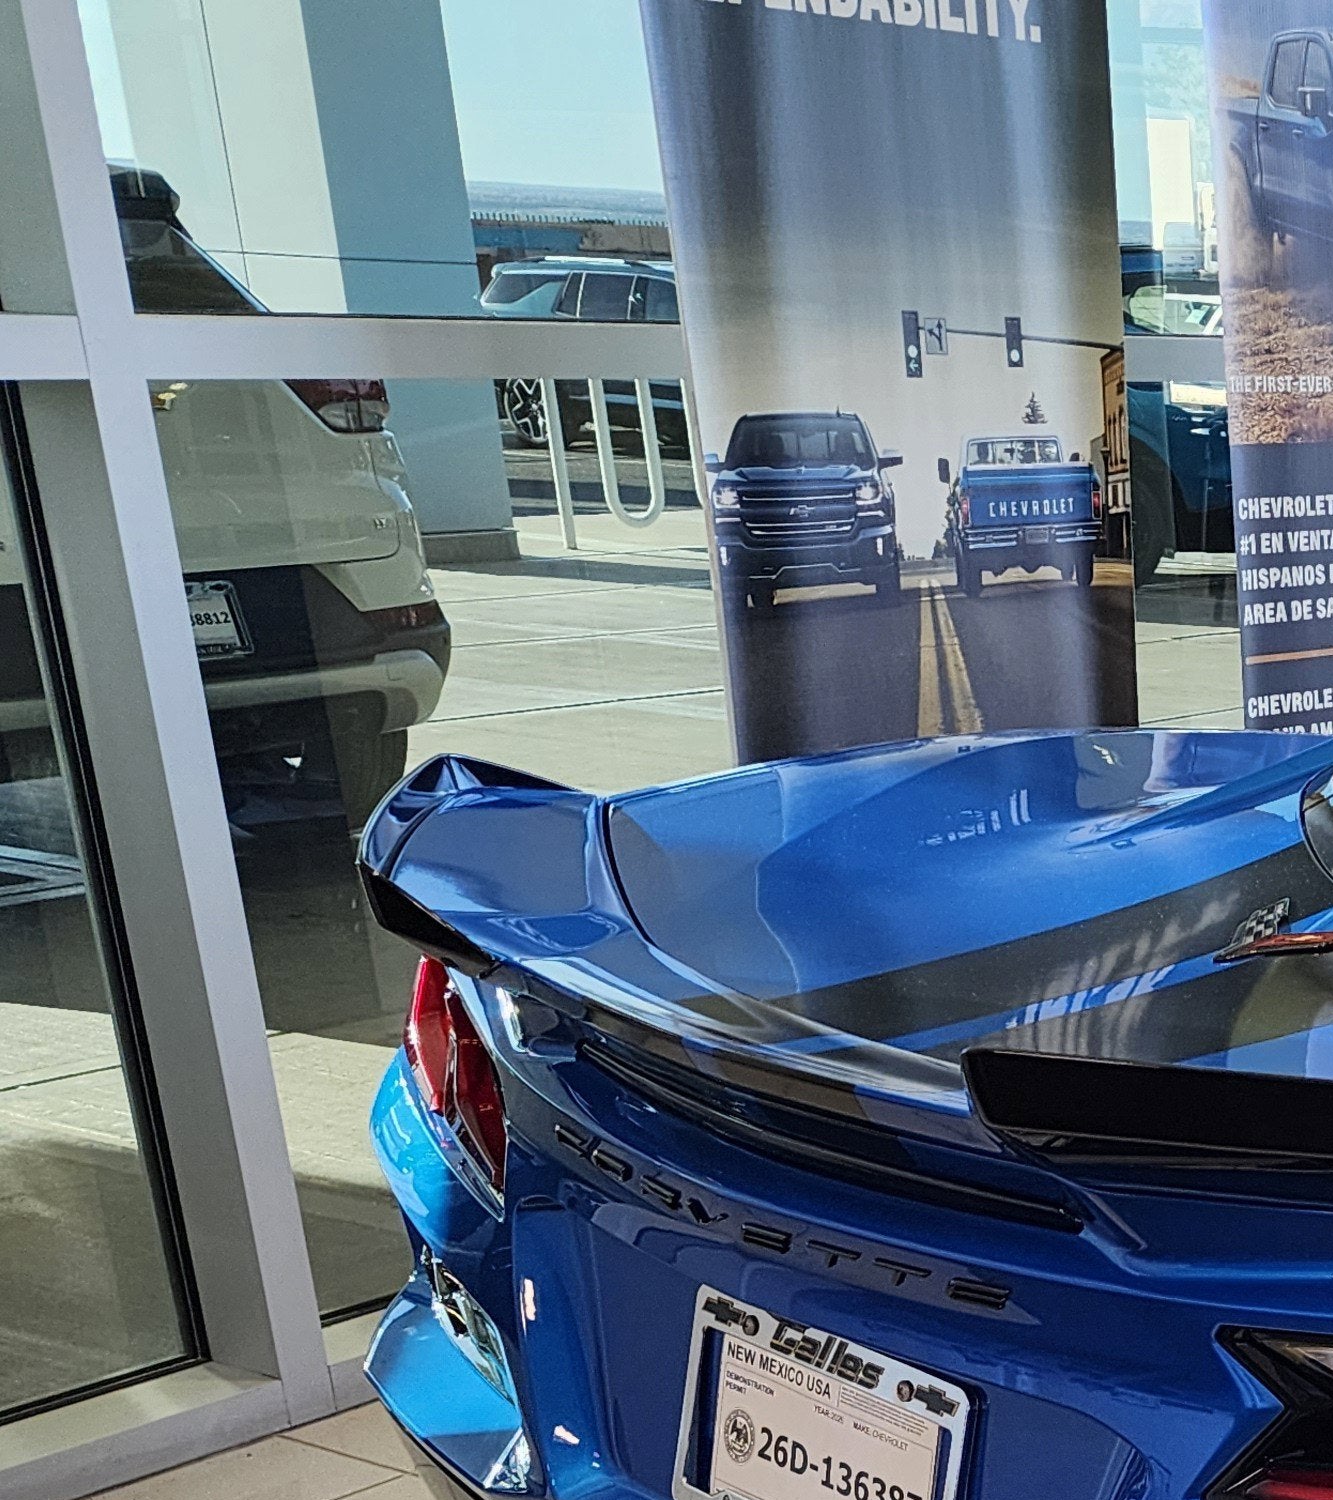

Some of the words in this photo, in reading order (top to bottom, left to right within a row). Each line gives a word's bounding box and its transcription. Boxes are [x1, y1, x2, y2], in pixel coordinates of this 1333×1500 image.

[1228, 375, 1251, 392] THE
[1254, 375, 1331, 393] FIRST-EVER
[988, 497, 1075, 517] CHEVROLET
[1240, 533, 1256, 556] #1
[1260, 532, 1284, 555] EN
[1241, 563, 1326, 592] HISPANOS
[191, 611, 231, 627] 8812
[1243, 599, 1288, 626] AREA
[1291, 597, 1313, 622] DE
[554, 1122, 1012, 1310] CORVETTE
[769, 1320, 886, 1390] Calles
[727, 1341, 757, 1366] NEW
[759, 1356, 804, 1387] MEXICO
[807, 1373, 832, 1400] USA
